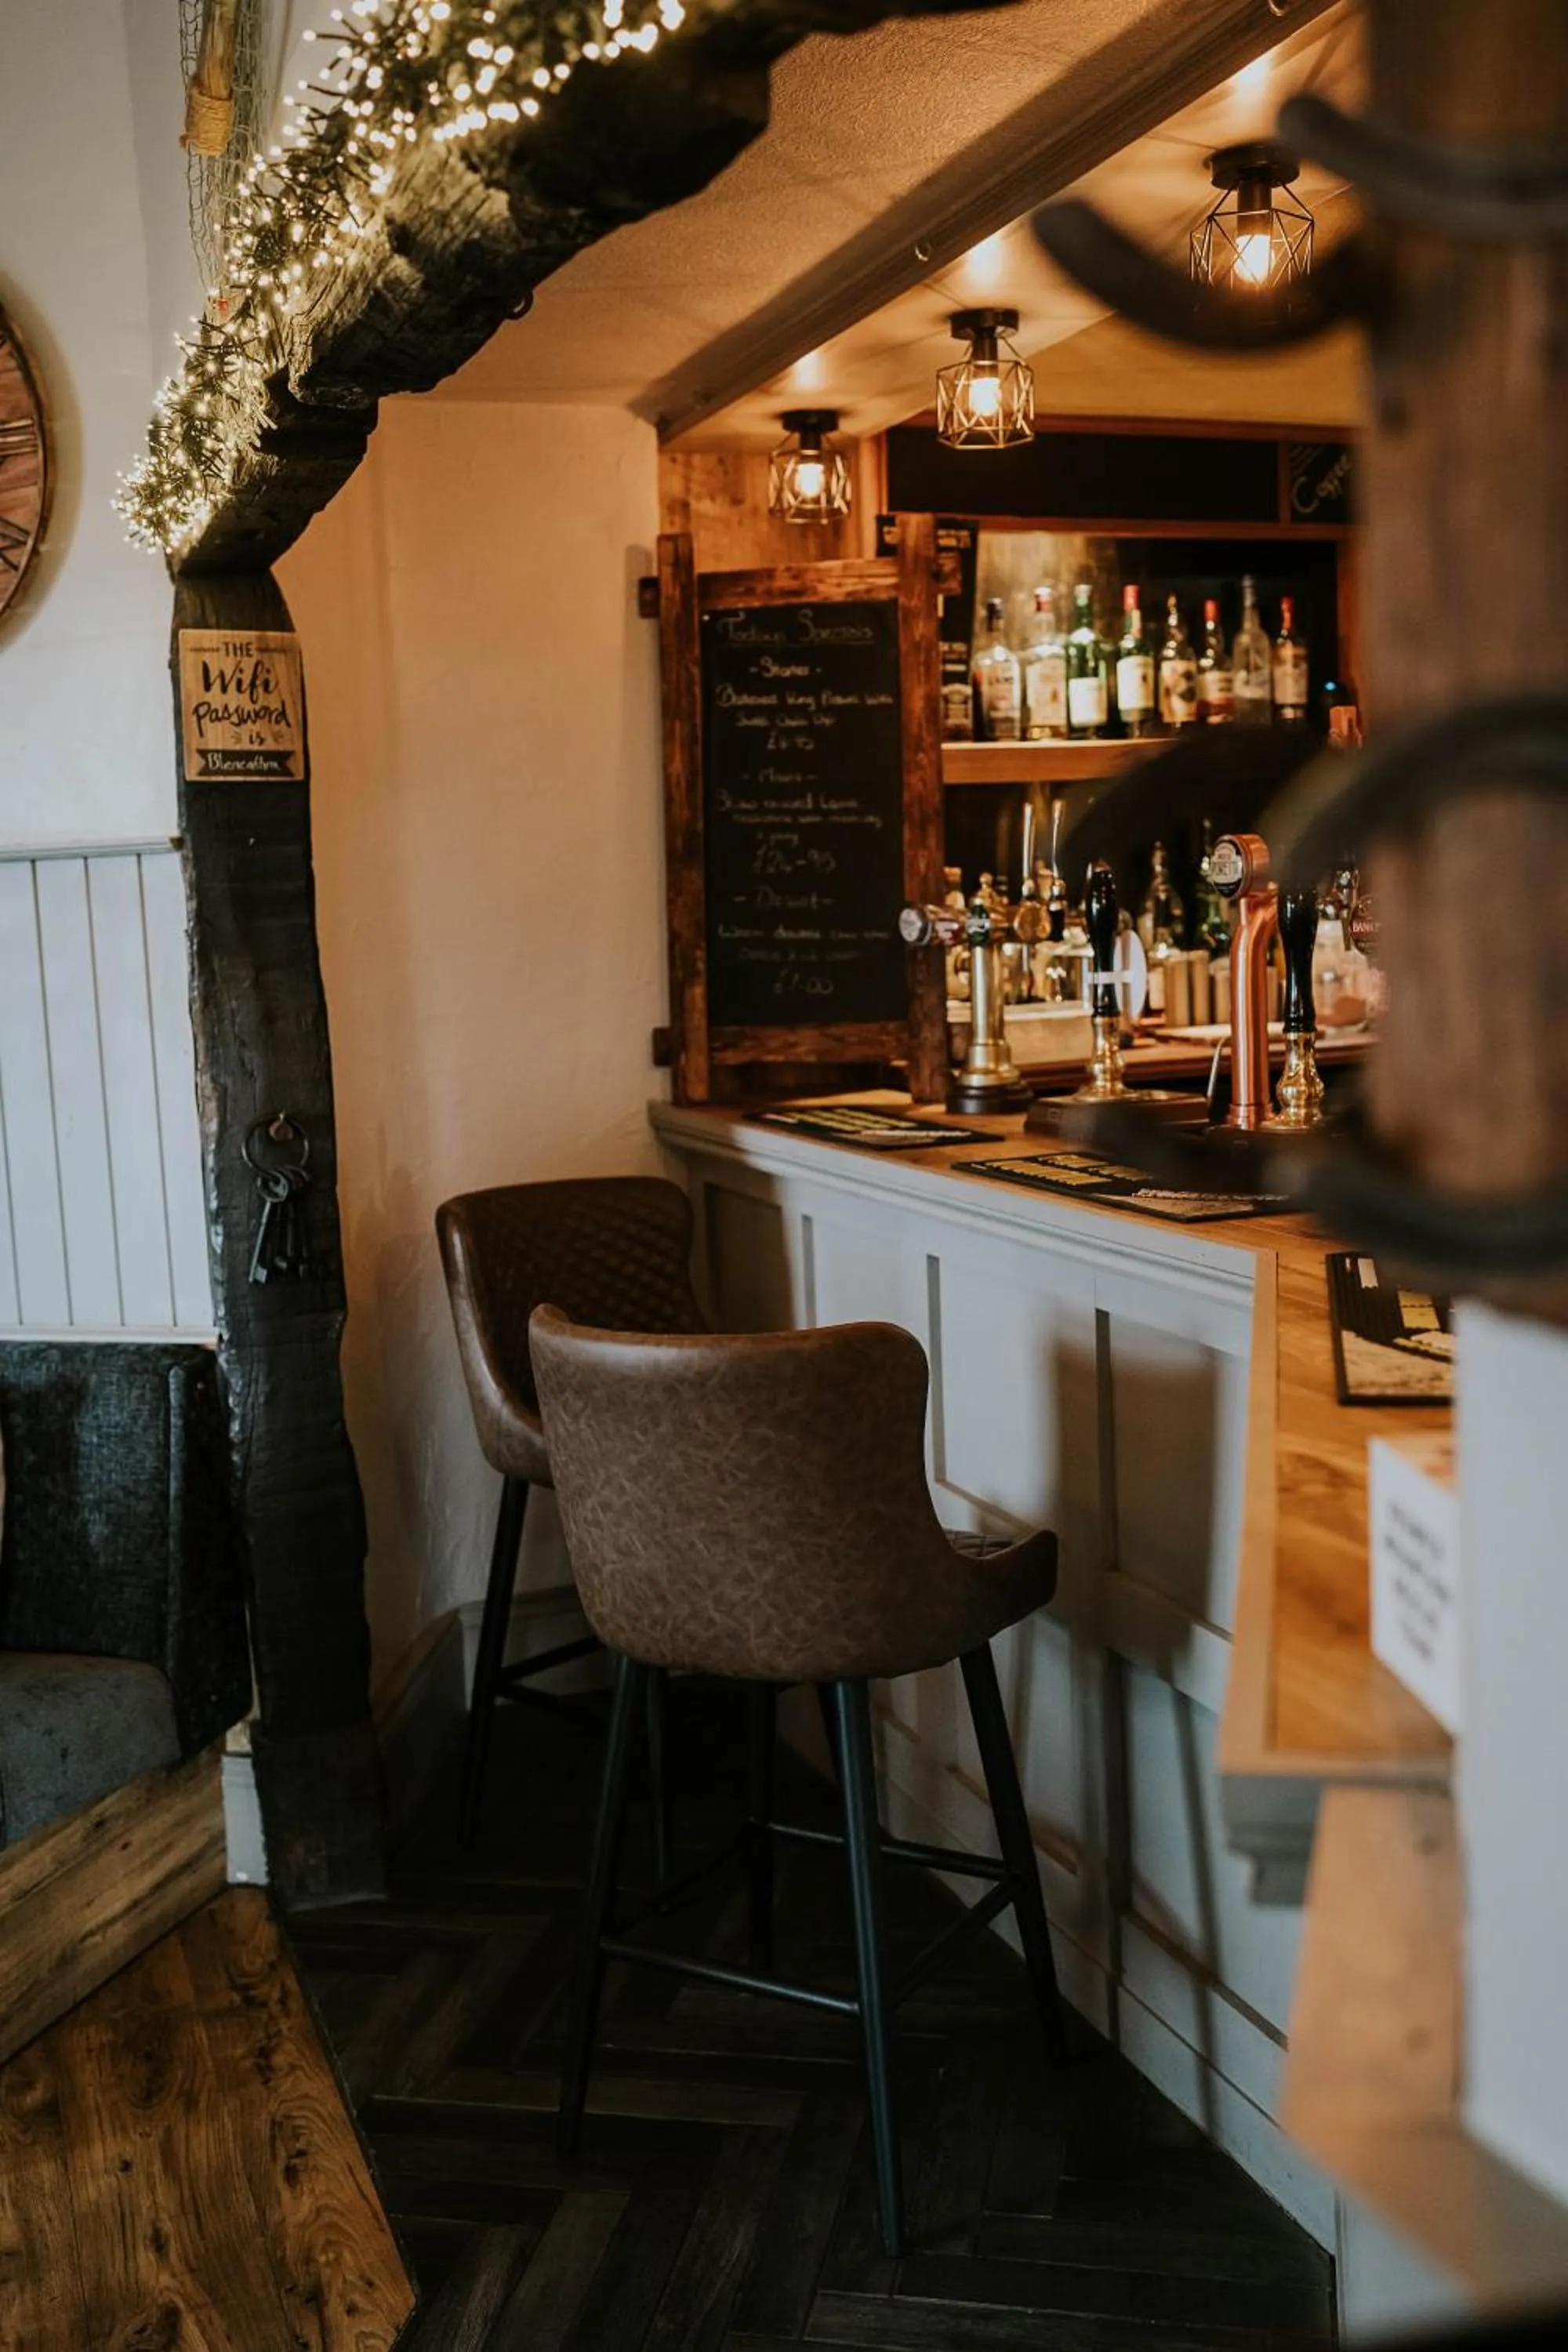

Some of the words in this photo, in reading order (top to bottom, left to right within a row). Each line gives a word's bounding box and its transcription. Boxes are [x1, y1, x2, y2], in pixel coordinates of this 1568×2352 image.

[223, 641, 254, 658] THE
[201, 659, 279, 705] Wifi
[191, 701, 292, 739] Password
[249, 729, 266, 746] is
